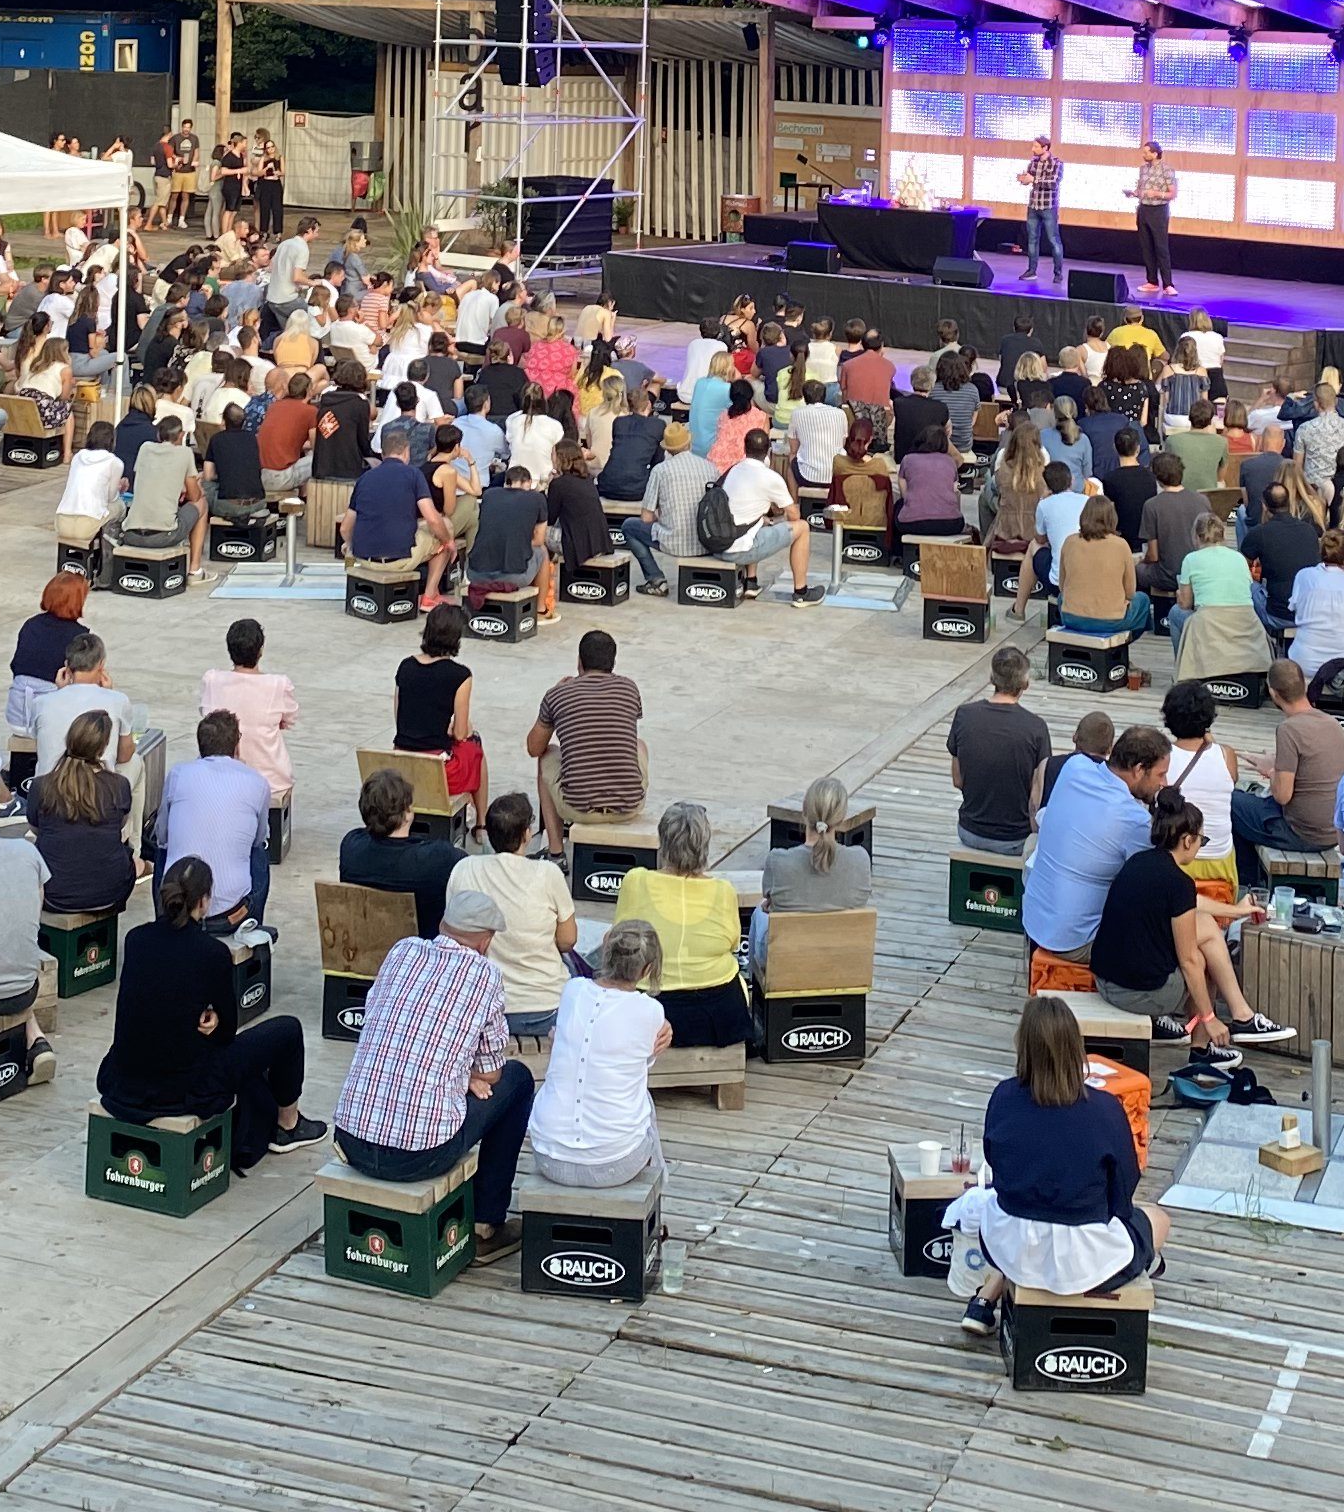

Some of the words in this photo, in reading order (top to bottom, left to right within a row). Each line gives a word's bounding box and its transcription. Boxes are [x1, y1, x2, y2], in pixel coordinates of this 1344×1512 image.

[79, 30, 96, 71] CON
[579, 586, 602, 596] RAUCH
[696, 589, 721, 599] RAUCH
[944, 624, 970, 634] RAUCH
[1067, 668, 1092, 680] RAUCH
[1214, 686, 1243, 696] RAUCH
[799, 1032, 843, 1046] RAUCH
[106, 1168, 165, 1193] fohrenburger
[346, 1246, 409, 1273] fohrenburger
[564, 1261, 616, 1280] RAUCH
[1059, 1356, 1116, 1375] RAUCH
